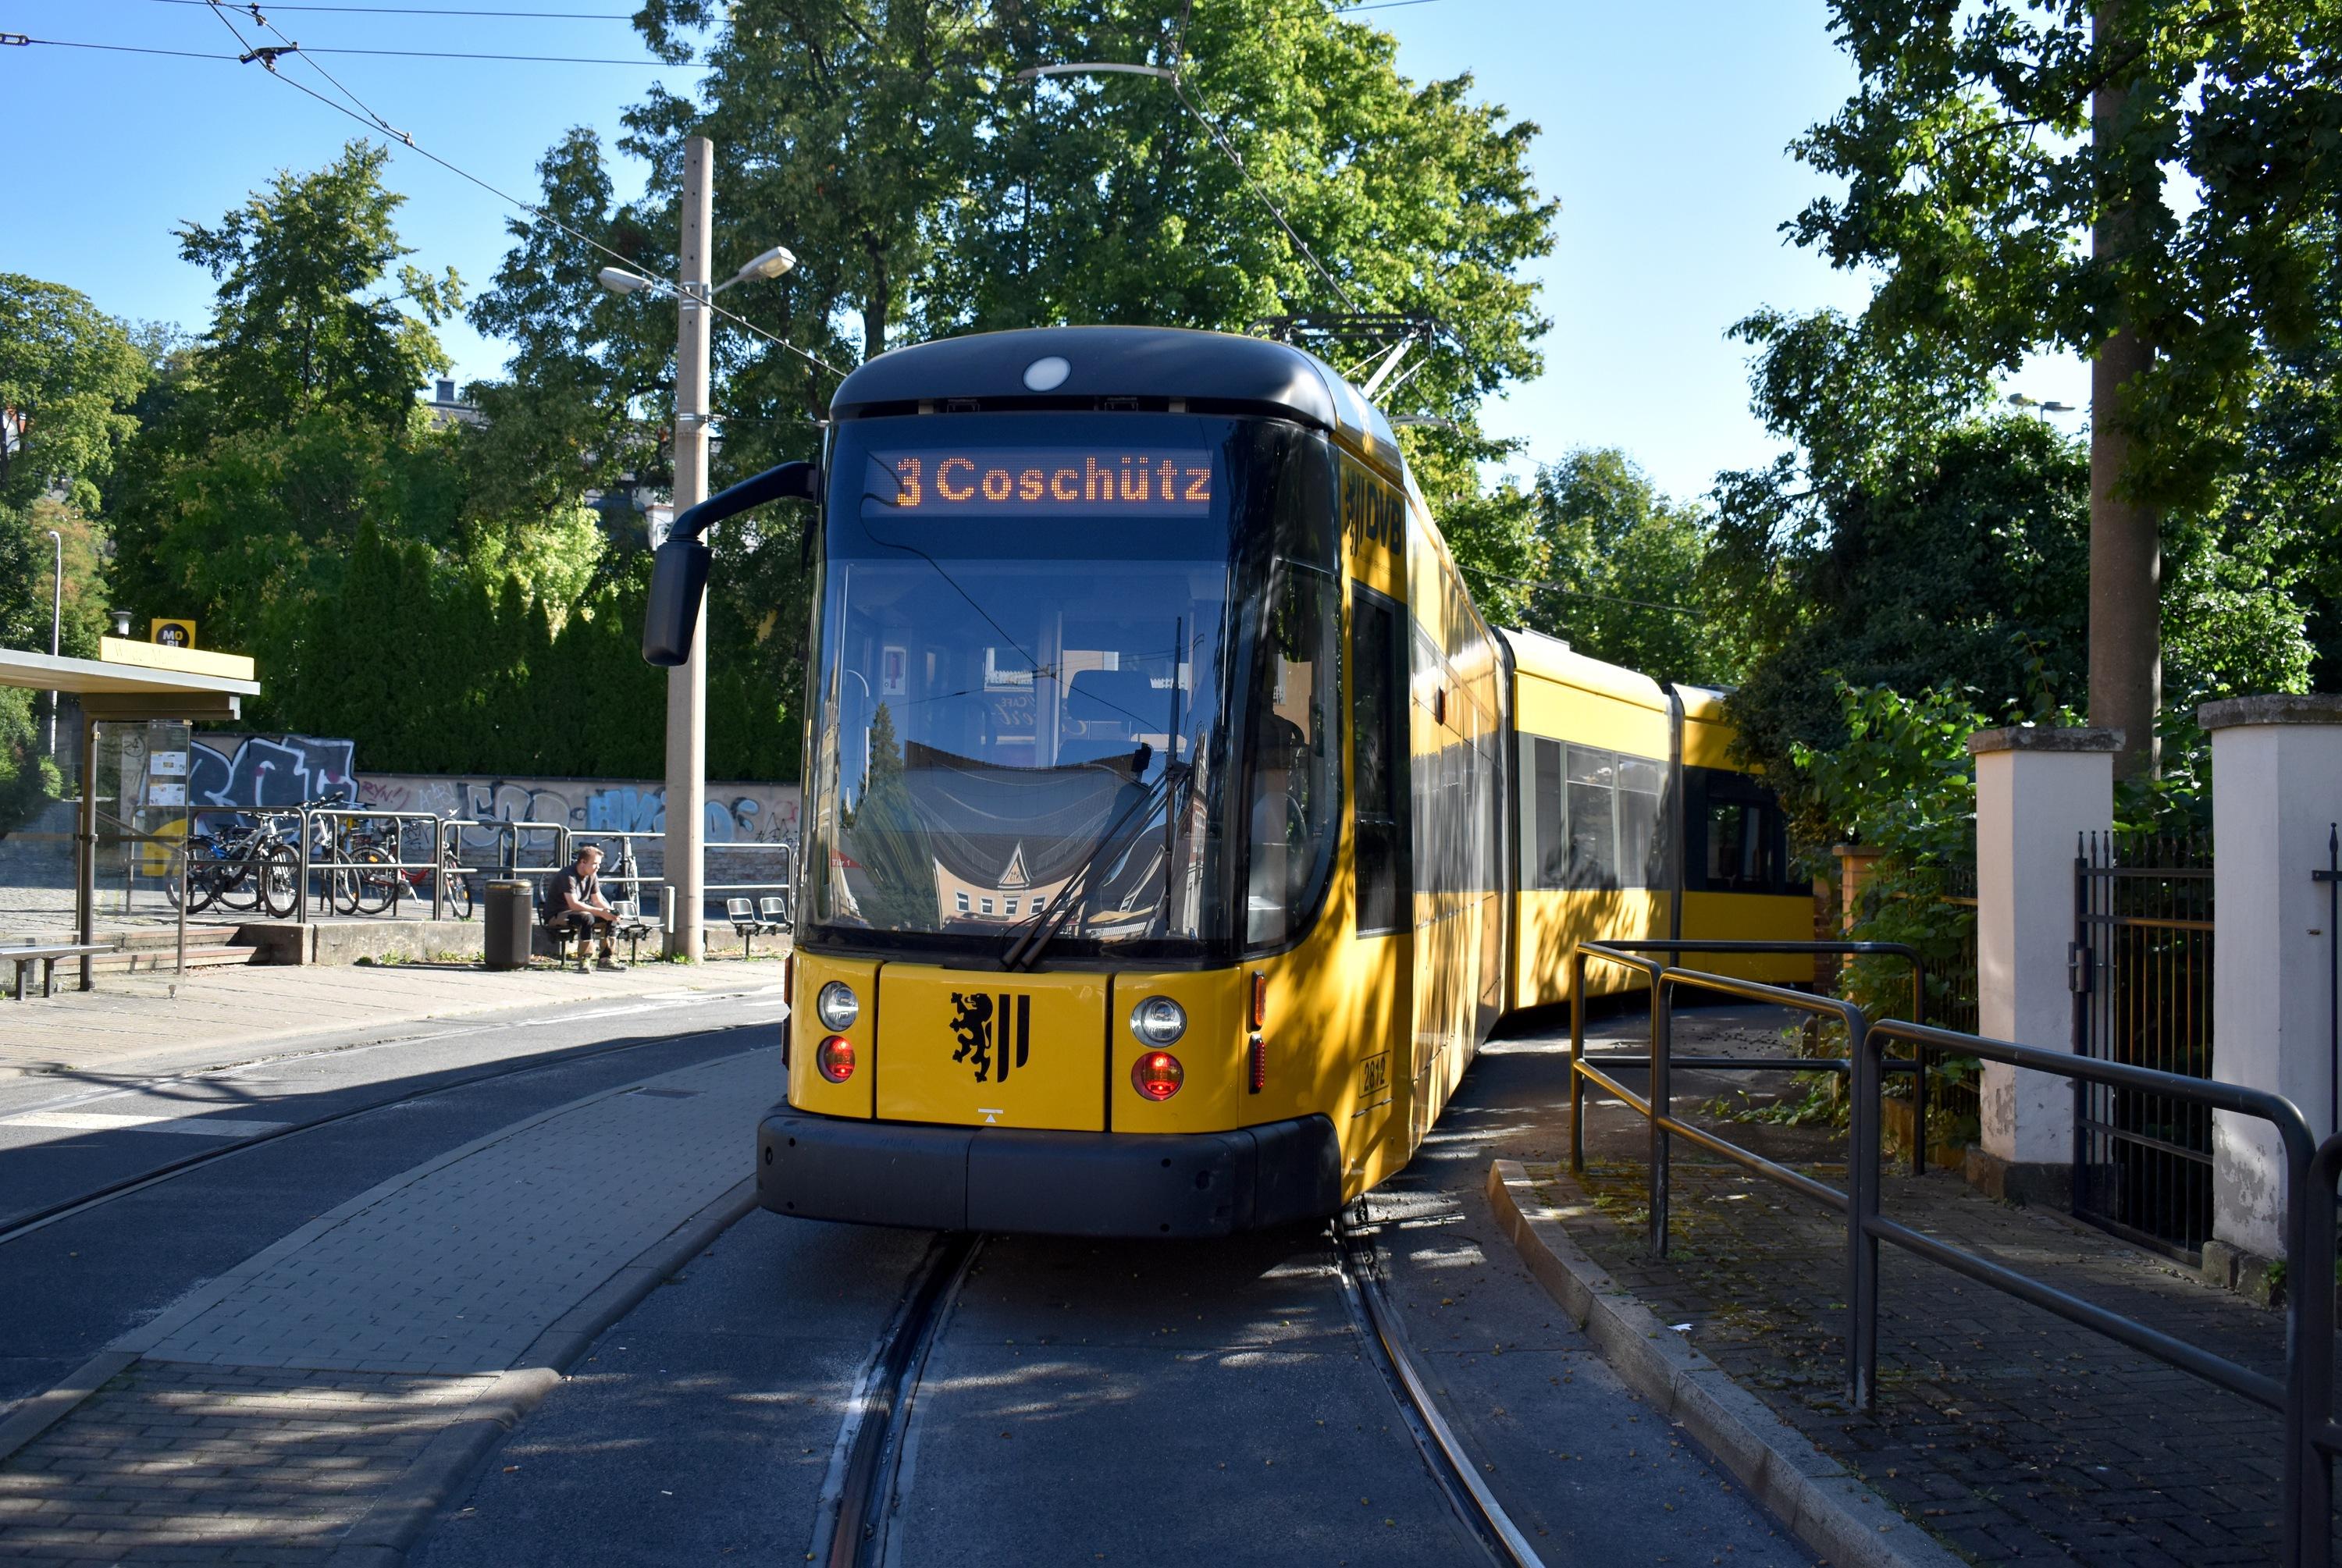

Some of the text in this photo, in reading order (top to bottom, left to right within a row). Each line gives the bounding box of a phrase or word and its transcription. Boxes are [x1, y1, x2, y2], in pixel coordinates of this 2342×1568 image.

[897, 457, 1211, 507] 3 Coschütz
[1366, 482, 1401, 556] DVB
[162, 630, 183, 641] MO
[1364, 1055, 1386, 1092] 2812
